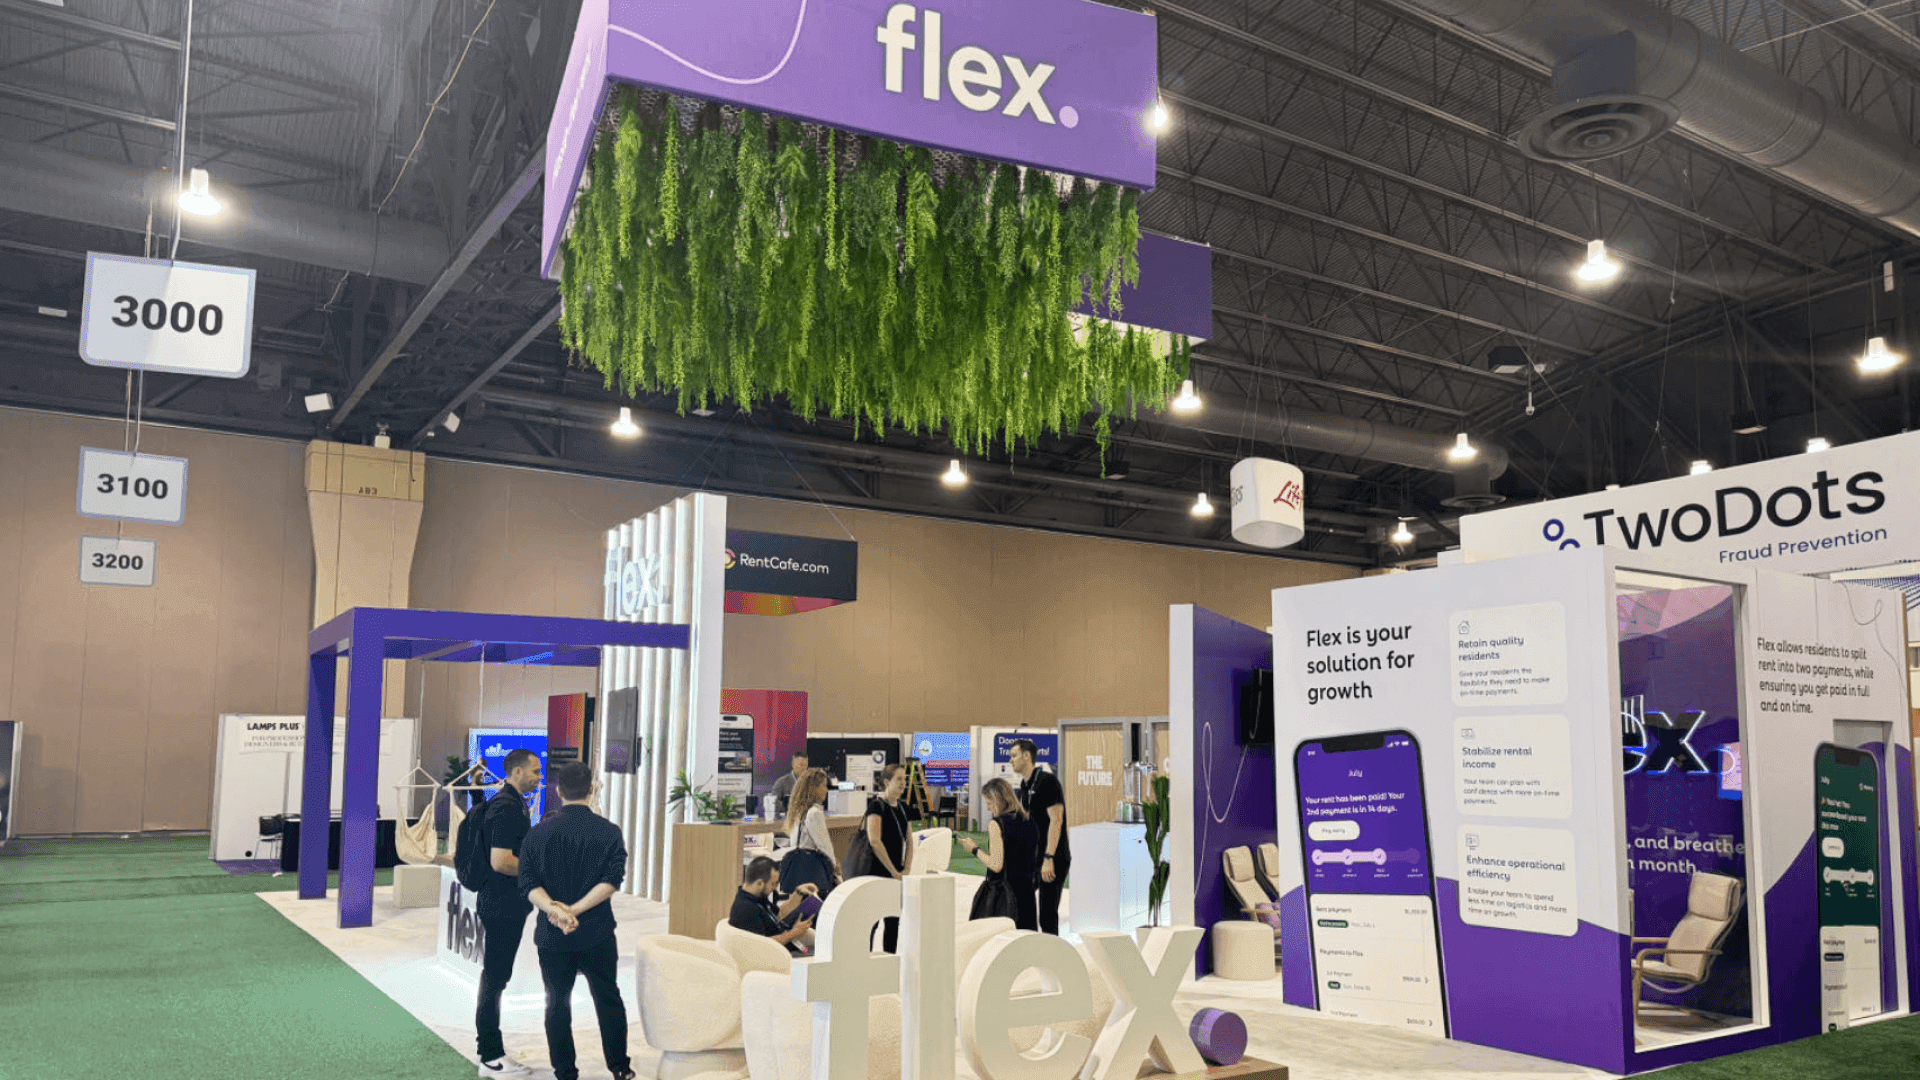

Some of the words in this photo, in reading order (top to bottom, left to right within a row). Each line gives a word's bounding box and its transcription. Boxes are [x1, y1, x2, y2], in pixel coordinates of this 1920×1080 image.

[876, 4, 1079, 130] flex.
[111, 295, 223, 336] 3000
[96, 473, 168, 500] 3100
[1583, 469, 1886, 551] TwoDots
[1718, 543, 1773, 565] Fraud
[1778, 526, 1888, 556] Prevention
[91, 552, 144, 571] 3200
[740, 553, 830, 575] RentCafe.com
[1306, 629, 1342, 647] Flex
[1346, 625, 1361, 644] is
[1366, 625, 1412, 647] your
[1458, 639, 1488, 649] Retain
[1489, 637, 1525, 648] quality
[1458, 652, 1500, 661] residents
[1757, 637, 1776, 651] Flex
[1776, 640, 1803, 654] allows
[1804, 643, 1840, 657] residents
[1841, 647, 1850, 658] to
[1851, 648, 1867, 662] split
[1307, 652, 1381, 674] solution
[1386, 650, 1415, 669] for
[1758, 660, 1776, 672] rent
[1777, 659, 1795, 673] into
[1796, 662, 1811, 675] two
[1812, 665, 1854, 679] payments,
[1854, 666, 1874, 679] while
[1307, 680, 1373, 705] growth
[1759, 679, 1796, 696] ensuring
[1798, 683, 1814, 697] you
[1815, 683, 1829, 697] get
[1829, 683, 1847, 698] paid
[1848, 683, 1857, 696] in
[1857, 684, 1871, 697] full
[1760, 699, 1778, 712] and
[1780, 702, 1791, 713] on
[1792, 700, 1814, 714] time.
[247, 722, 277, 731] LAMPS
[279, 722, 300, 731] PLUS
[1462, 746, 1501, 756] Stabilize
[1504, 746, 1533, 756] rental
[1086, 755, 1104, 770] THE
[1462, 759, 1496, 769] income
[1077, 770, 1113, 786] FUTURE
[1348, 769, 1363, 778] July
[1321, 796, 1334, 804] rent
[1336, 795, 1350, 803] has
[1350, 794, 1367, 802] been
[1387, 792, 1405, 800] Your
[1307, 807, 1320, 815] 2nd
[1320, 806, 1351, 816] payment
[1352, 805, 1358, 813] is
[1359, 804, 1367, 813] in
[1377, 804, 1398, 814] days.
[1634, 836, 1669, 850] and
[1466, 855, 1506, 867] Enhance
[1508, 860, 1566, 871] operational
[1467, 868, 1511, 882] efficiency
